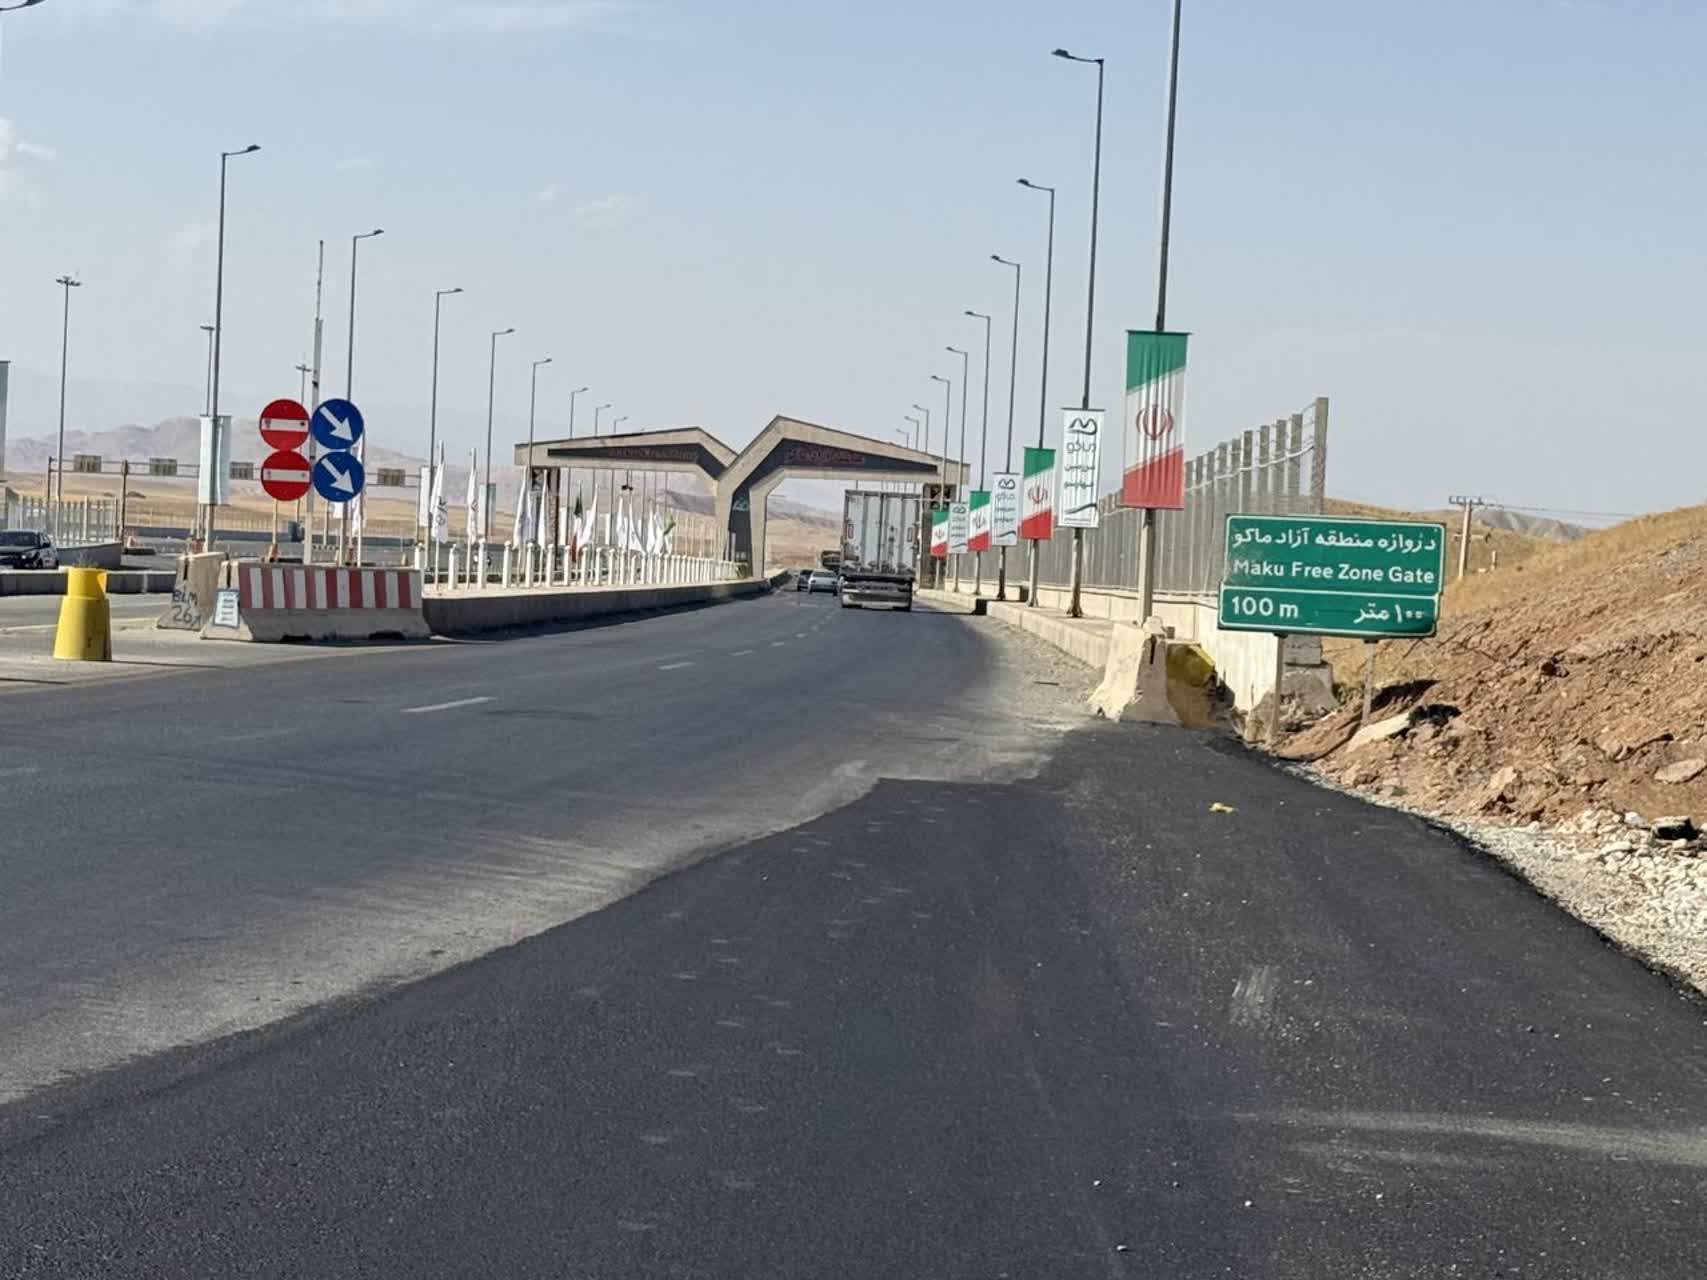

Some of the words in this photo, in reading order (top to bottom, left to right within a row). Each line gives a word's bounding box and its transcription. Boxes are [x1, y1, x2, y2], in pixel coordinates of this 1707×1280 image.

[1233, 528, 1272, 548] ماکو
[1275, 528, 1309, 548] آزاد
[1315, 530, 1374, 548] منطقه
[1378, 533, 1437, 553] دروازه
[1233, 560, 1285, 577] Maku
[1291, 562, 1333, 579] Free
[1338, 564, 1384, 581] Zone
[1388, 567, 1435, 584] Gate
[1231, 596, 1274, 617] 100
[1279, 603, 1299, 619] m
[1353, 602, 1389, 624] متر
